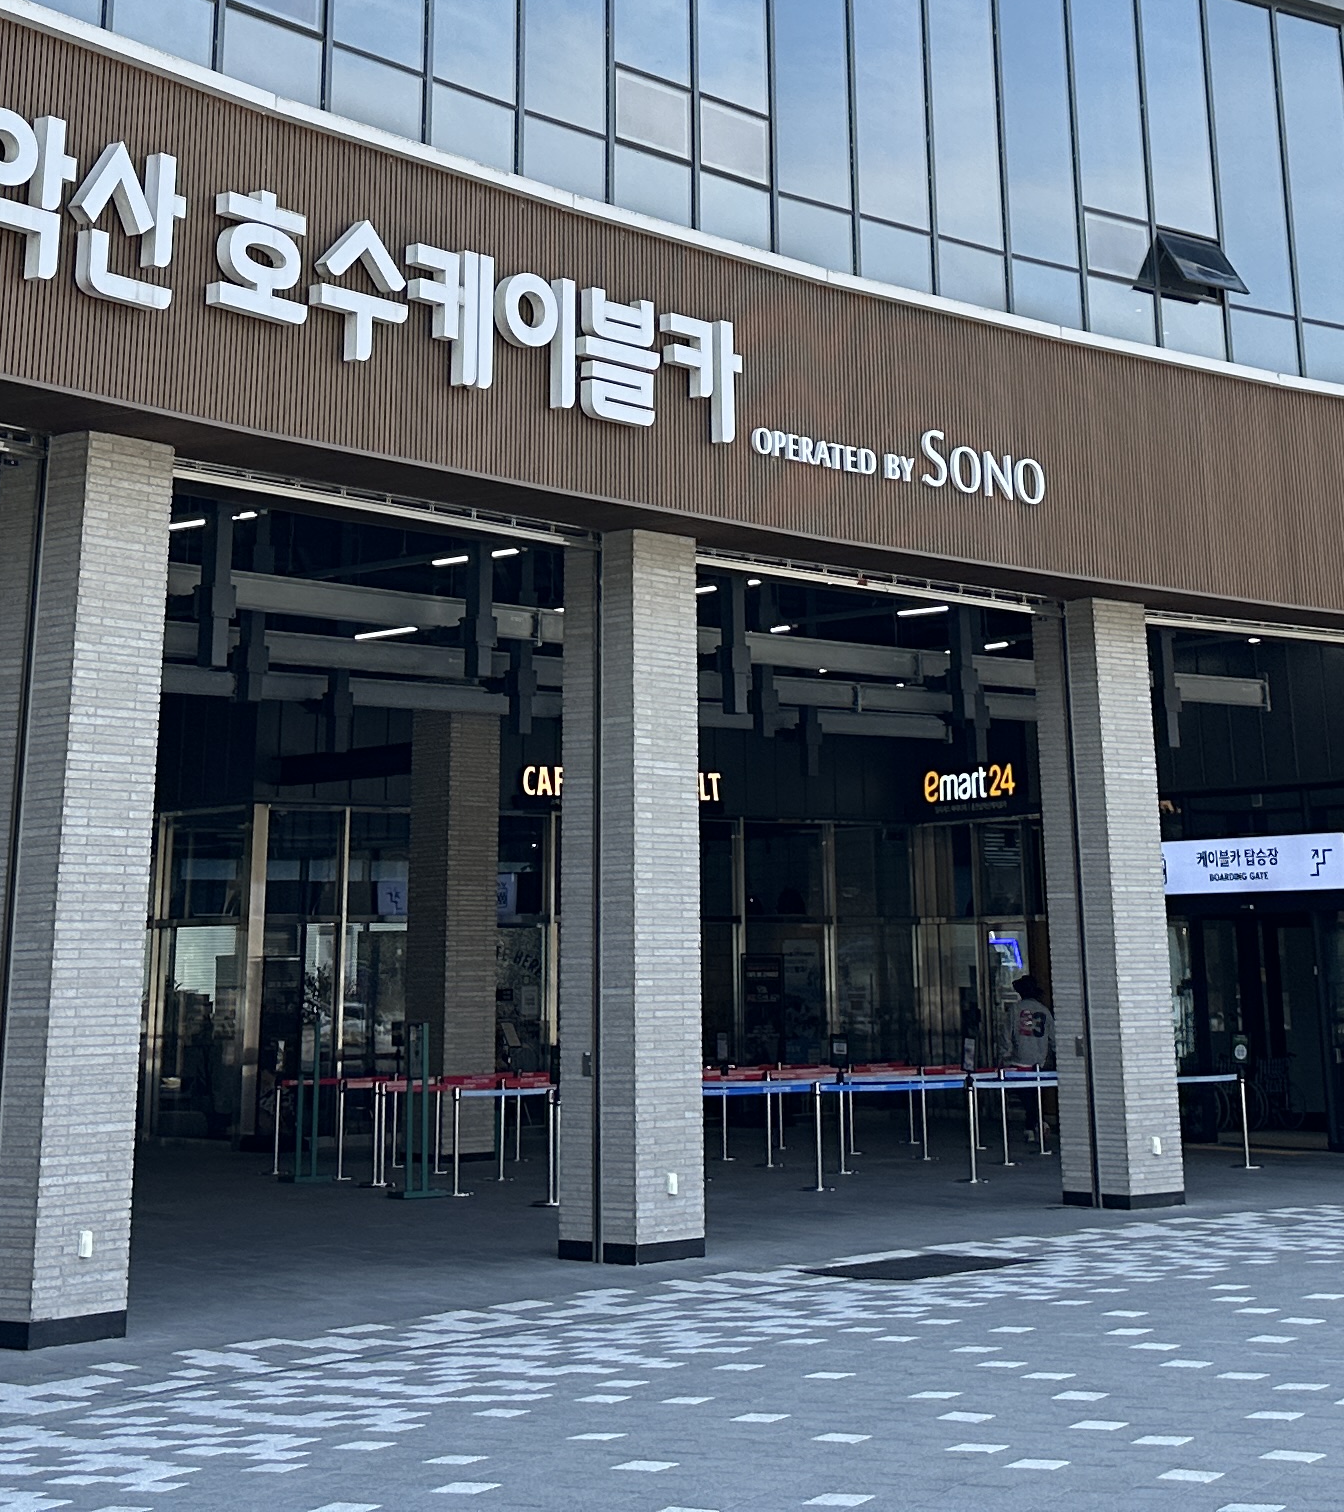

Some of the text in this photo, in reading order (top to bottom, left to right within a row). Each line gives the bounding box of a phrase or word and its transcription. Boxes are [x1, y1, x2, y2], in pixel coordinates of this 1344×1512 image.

[205, 189, 743, 445] 호수케이블카
[751, 426, 1046, 505] OPERATED BY SONO
[522, 765, 564, 796] CAF
[923, 762, 1016, 803] emart24
[1196, 847, 1279, 868] 케이블카 탑승장
[1209, 871, 1269, 882] BOARDING GATE
